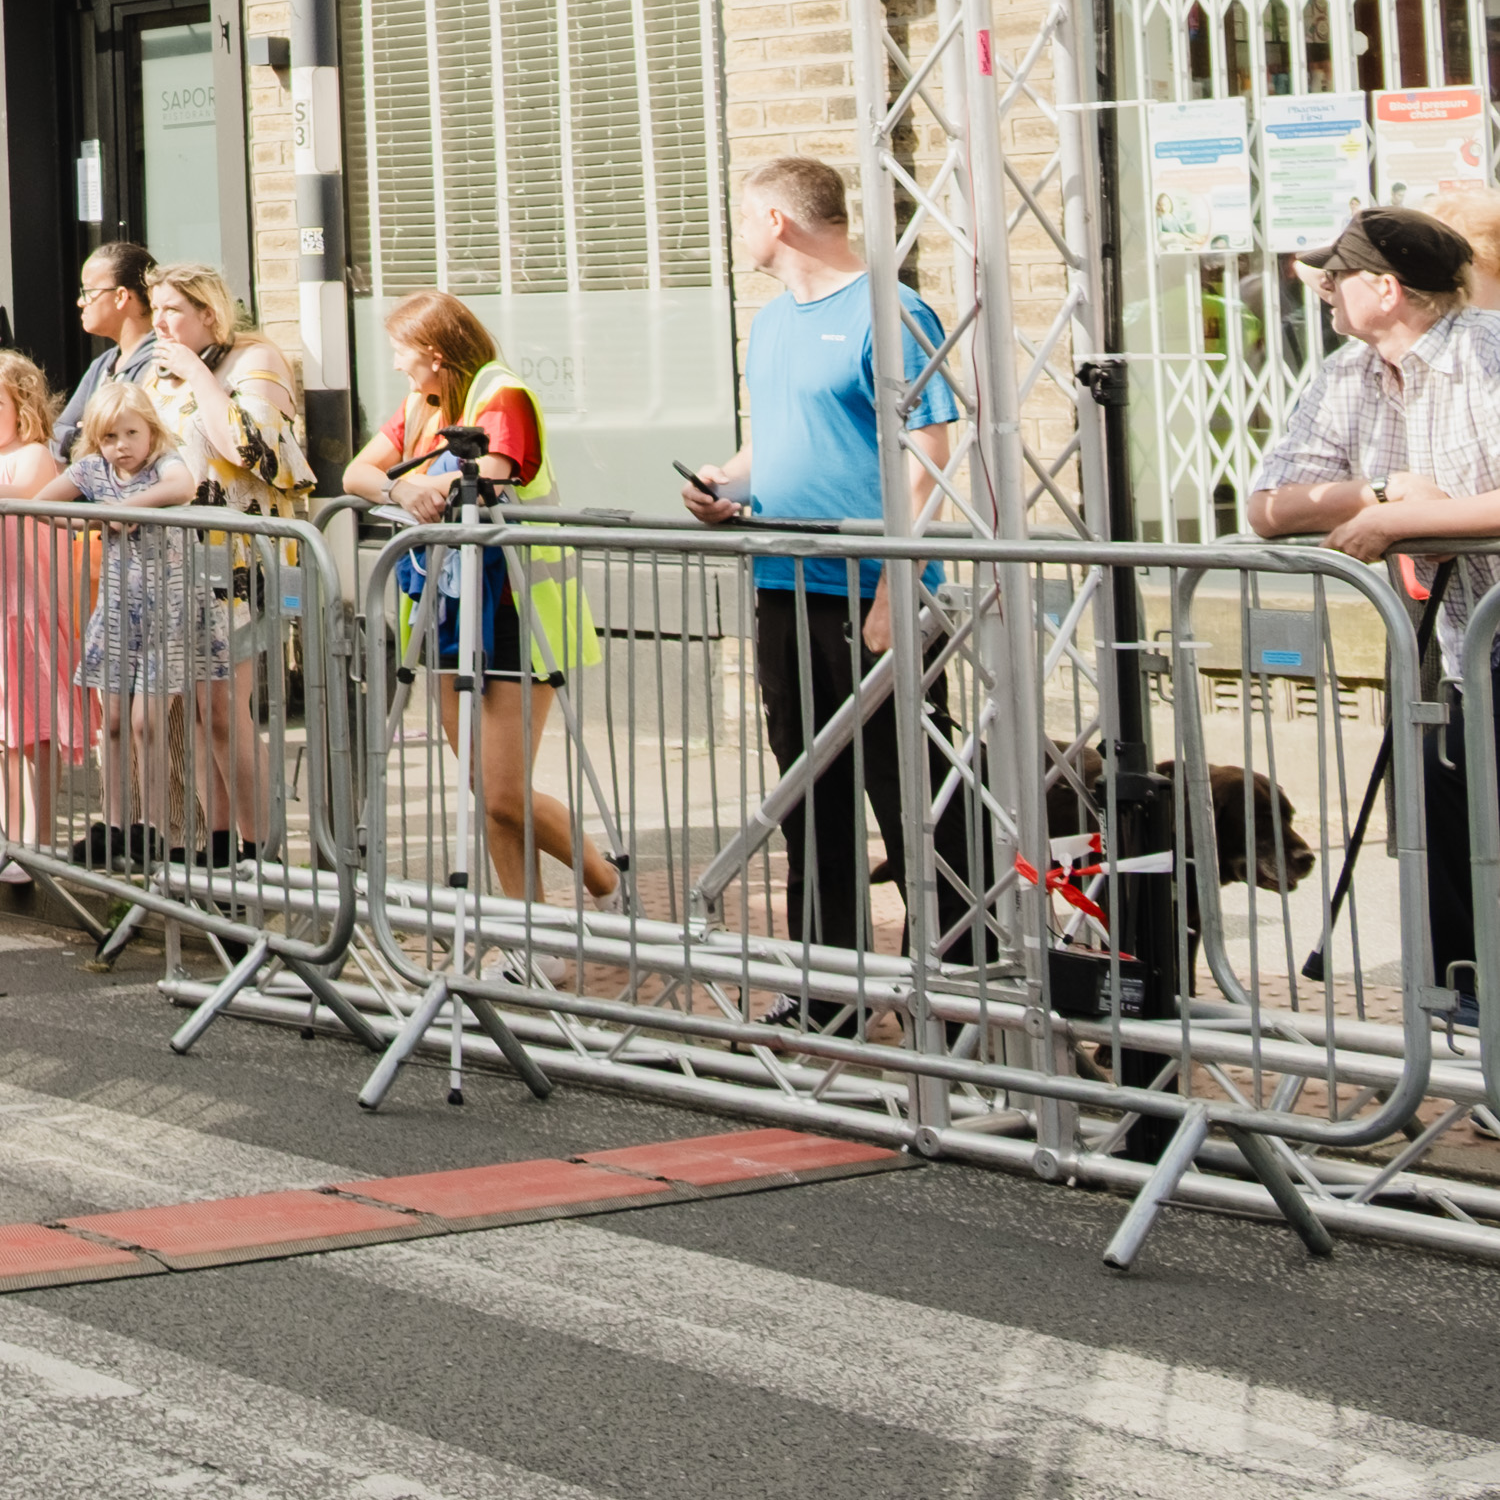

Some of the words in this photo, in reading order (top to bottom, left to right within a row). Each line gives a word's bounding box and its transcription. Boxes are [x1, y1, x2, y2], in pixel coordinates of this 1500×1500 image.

[161, 86, 216, 111] SAPOR
[1389, 101, 1420, 112] Blood
[1422, 99, 1469, 111] pressure
[162, 108, 216, 121] RISTORAN
[294, 102, 306, 123] S
[295, 126, 306, 146] 3
[520, 355, 588, 387] PORI
